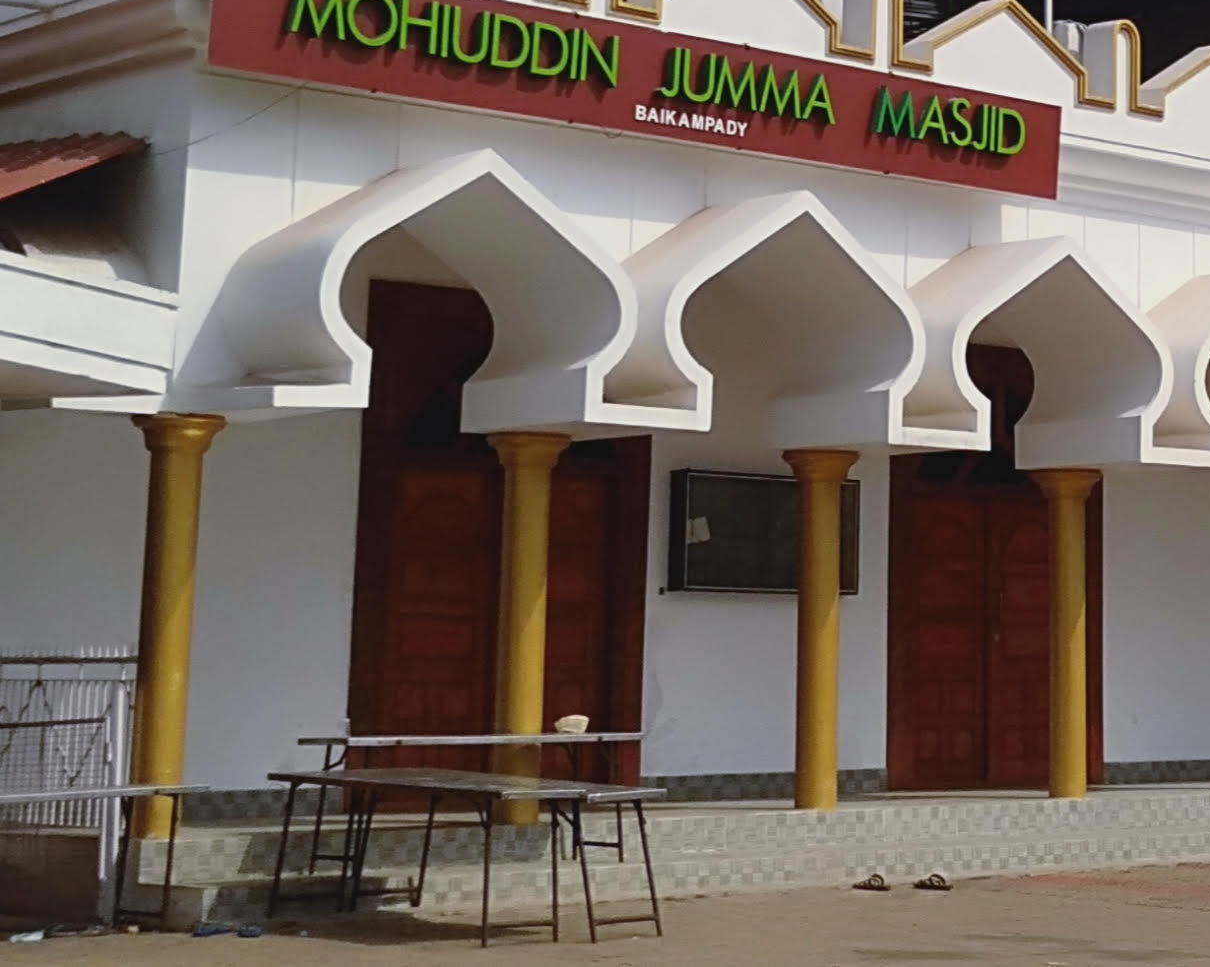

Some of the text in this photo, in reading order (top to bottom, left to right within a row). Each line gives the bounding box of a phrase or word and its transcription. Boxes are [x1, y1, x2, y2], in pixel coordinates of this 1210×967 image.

[635, 104, 748, 138] BAIKAMPADY
[659, 47, 835, 125] JUMMA
[873, 86, 1025, 155] MASJID
